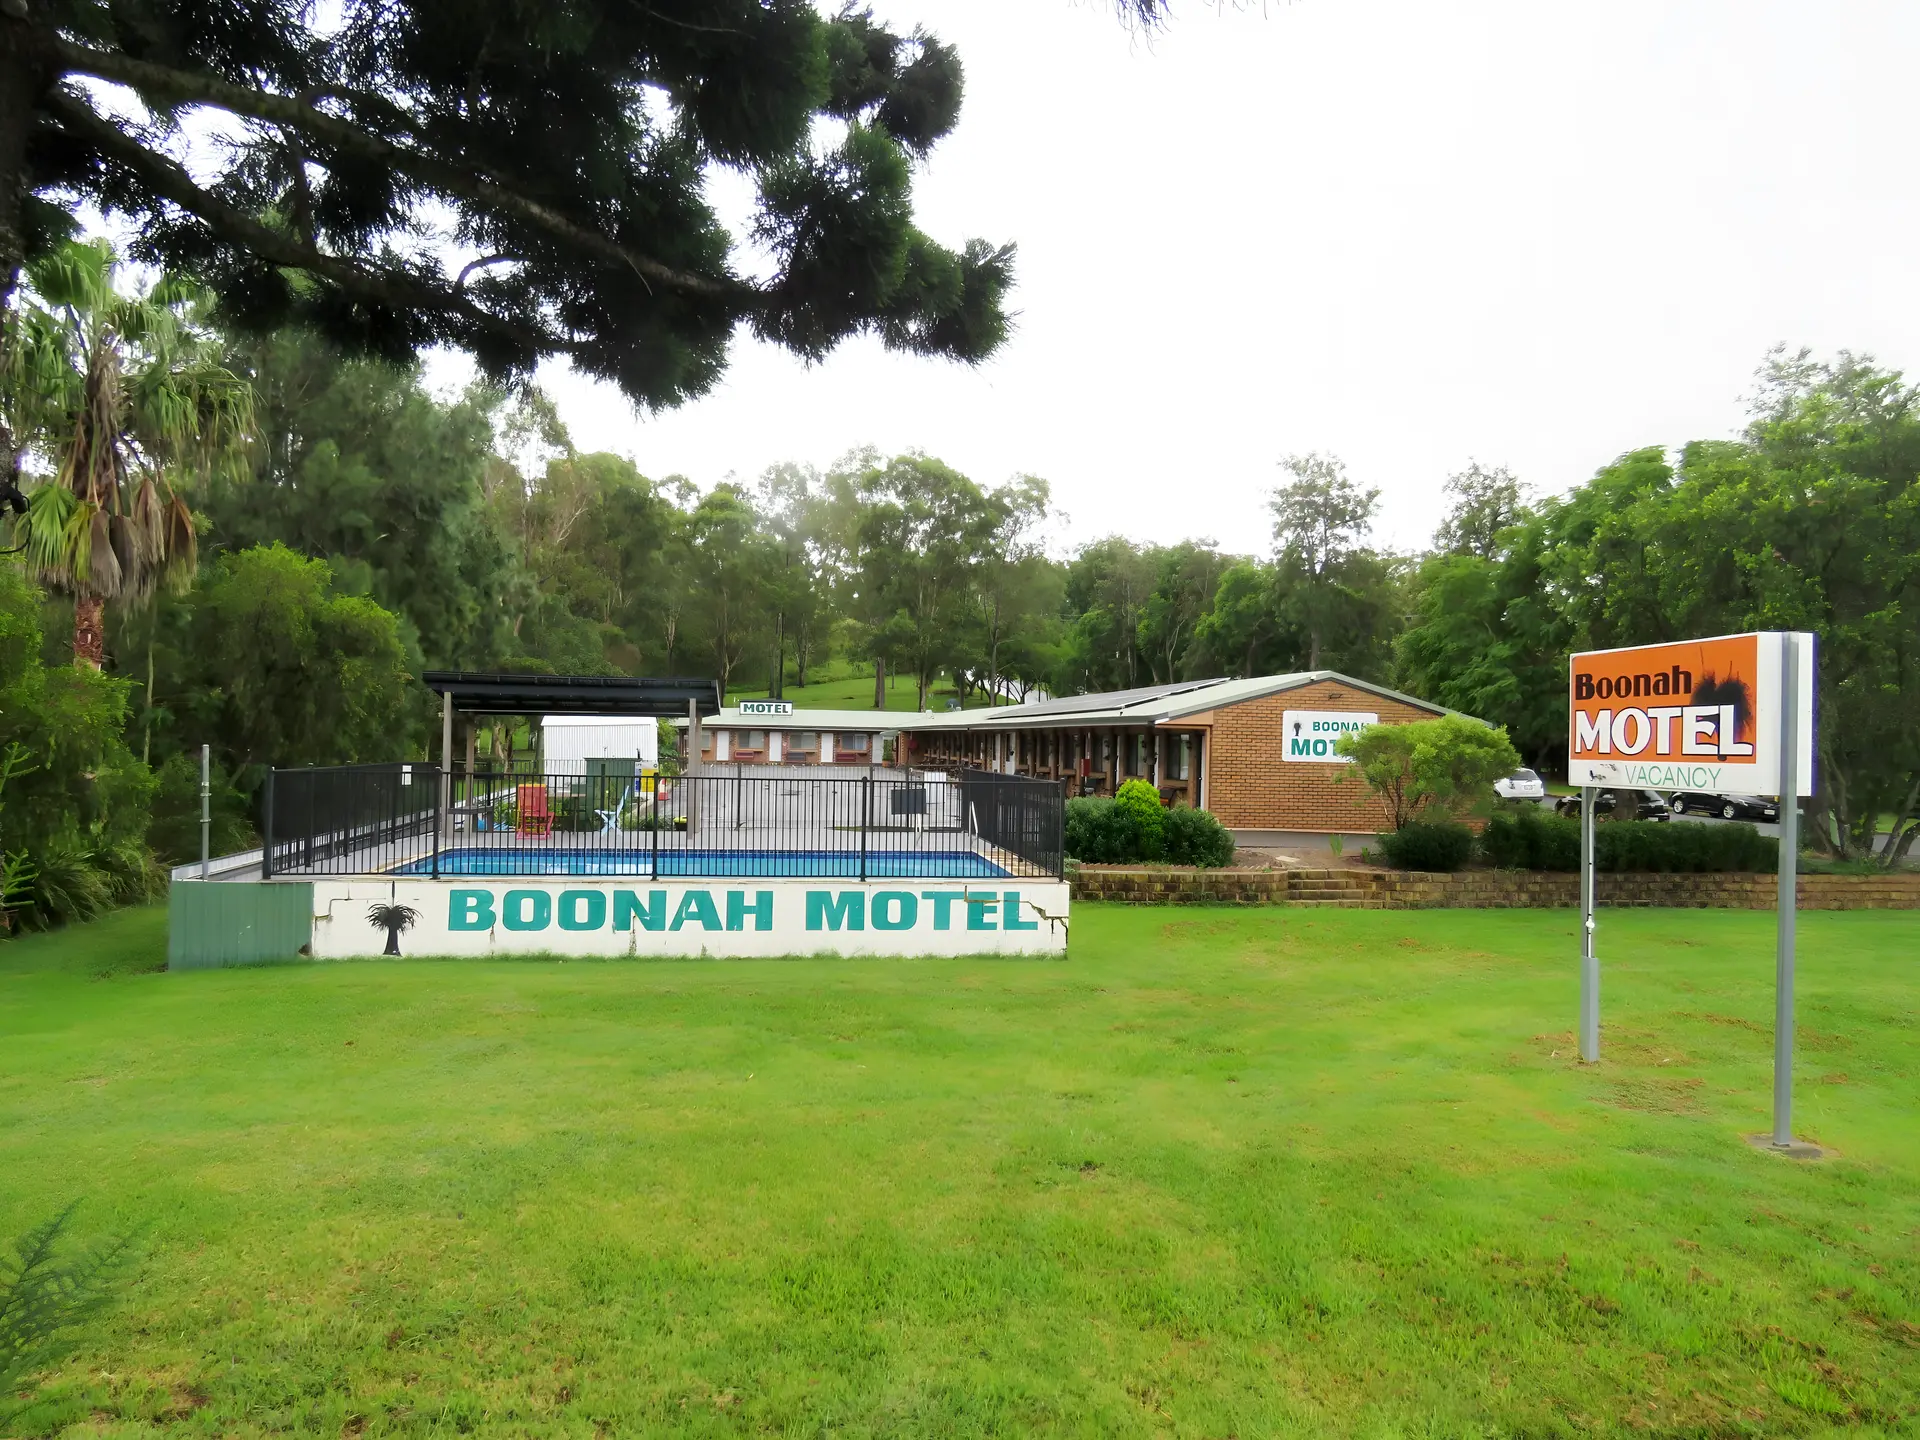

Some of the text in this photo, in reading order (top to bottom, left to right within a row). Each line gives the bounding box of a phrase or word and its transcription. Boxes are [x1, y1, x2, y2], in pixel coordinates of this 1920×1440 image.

[1575, 665, 1692, 700] Boonah
[743, 703, 789, 714] MOTEL
[1574, 704, 1754, 756] MOTEL
[1624, 764, 1722, 789] VACANCY
[448, 889, 1039, 932] BOONAH MOTEL
